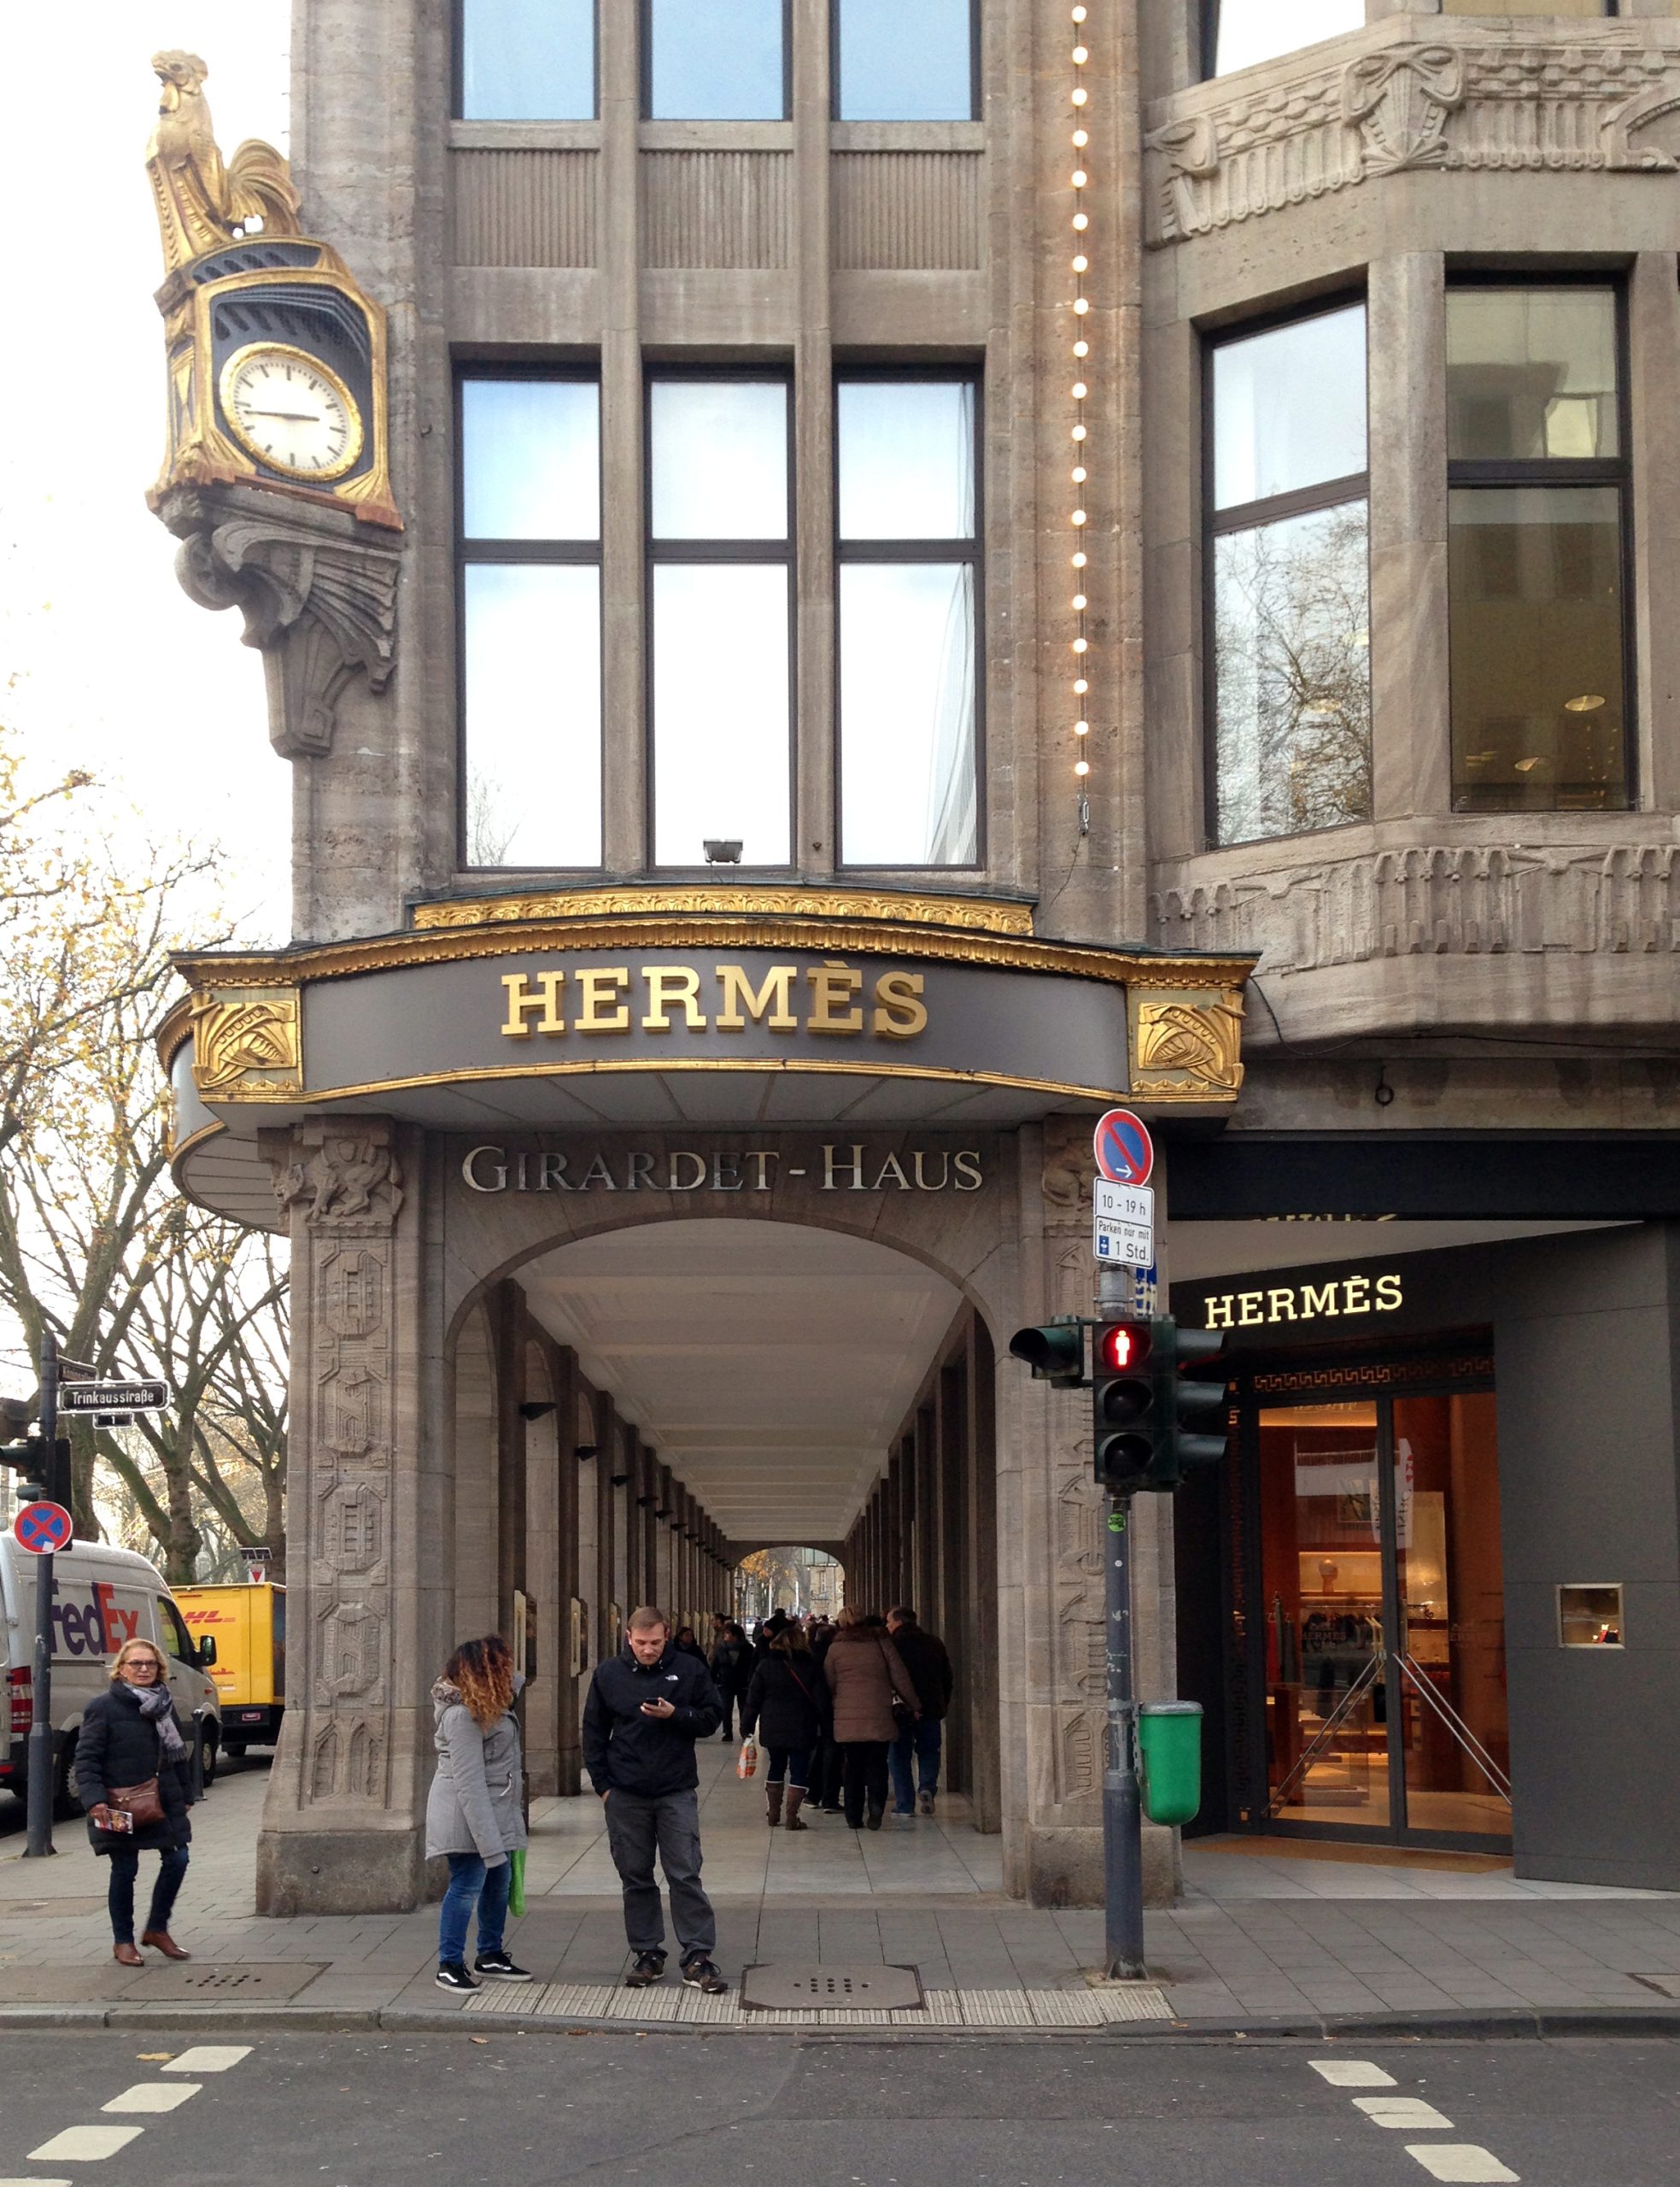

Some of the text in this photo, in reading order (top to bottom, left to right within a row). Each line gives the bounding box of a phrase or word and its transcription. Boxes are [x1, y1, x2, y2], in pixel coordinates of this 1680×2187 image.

[500, 960, 928, 1039] HERMÈS
[1102, 1193, 1113, 1209] 10
[1126, 1199, 1136, 1213] 19
[1139, 1202, 1146, 1216] h
[1098, 1220, 1150, 1240] Parken nur mit
[1115, 1240, 1149, 1261] 1 Std.
[1204, 1275, 1403, 1329] HERMÈS
[72, 1389, 155, 1404] Trinkausstraße
